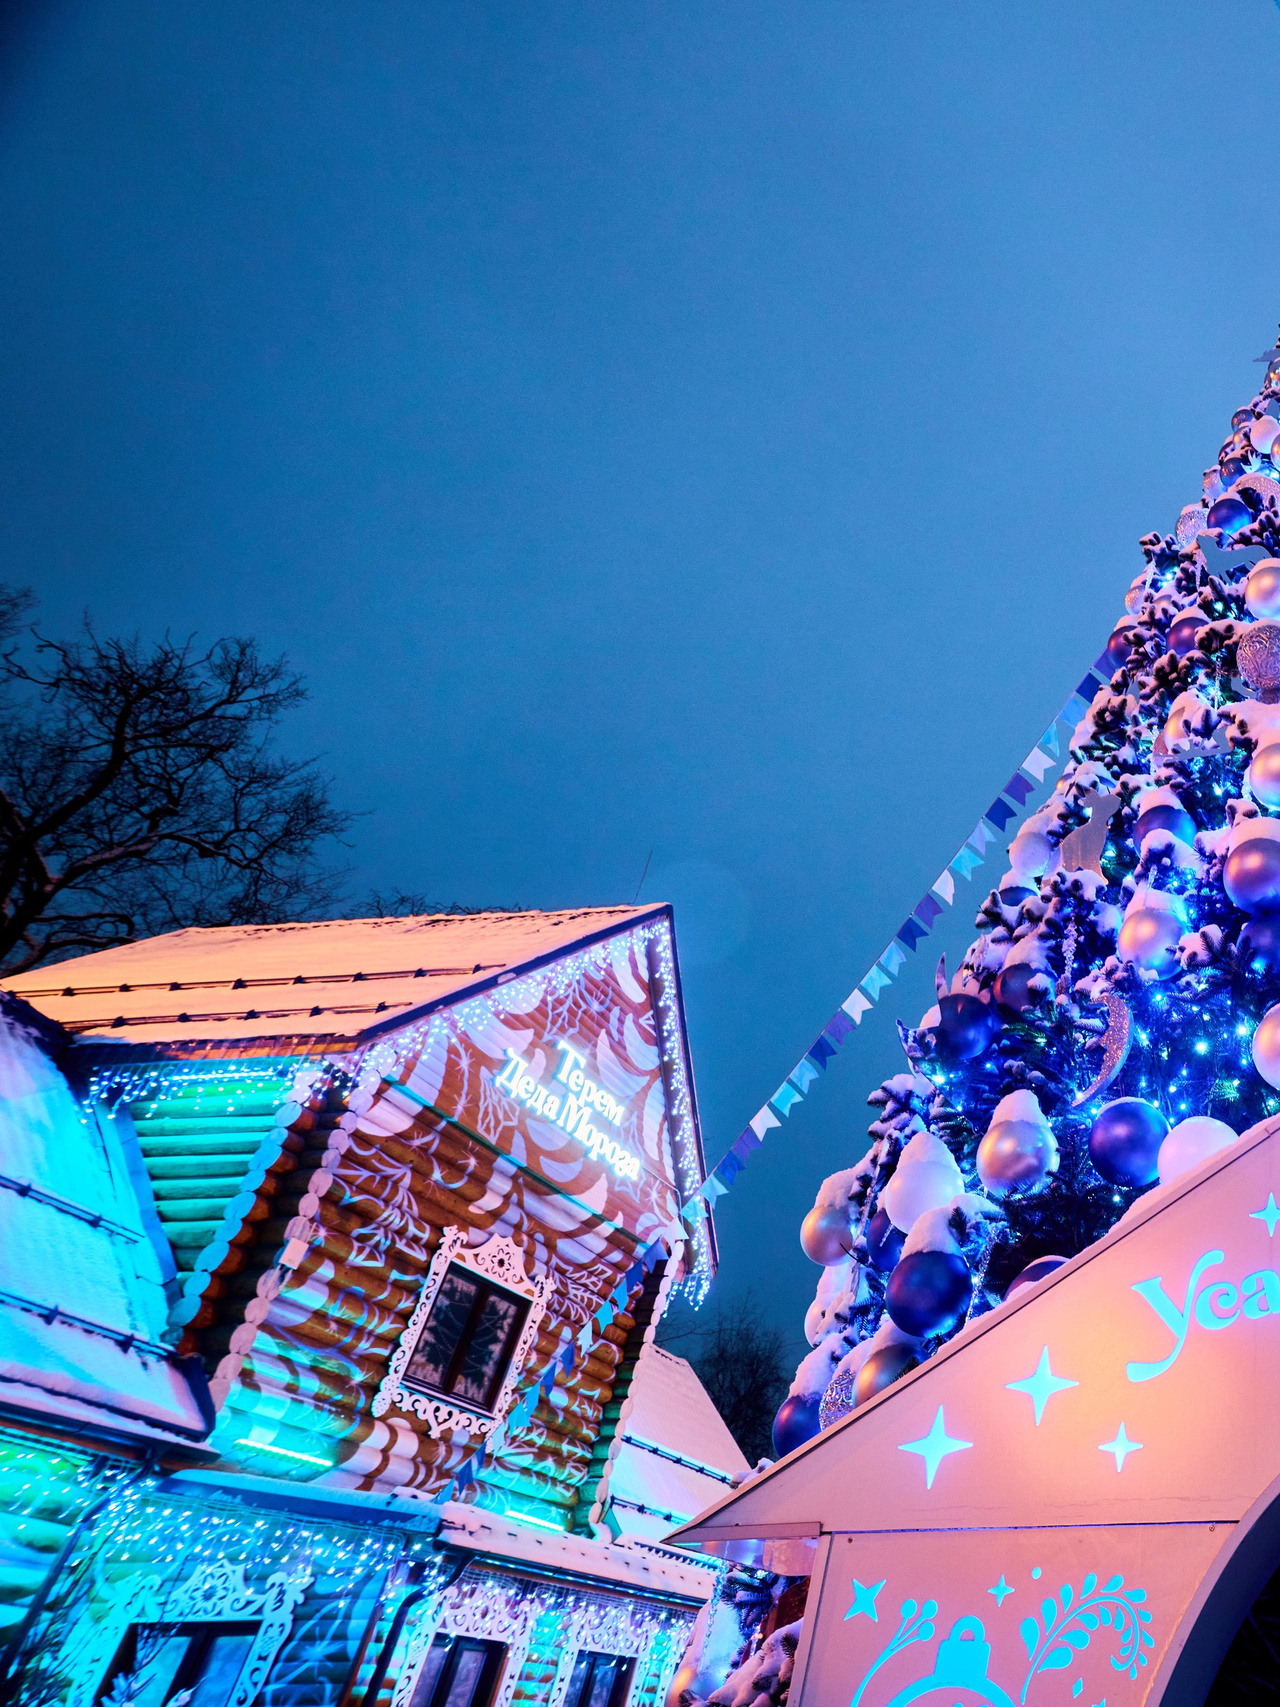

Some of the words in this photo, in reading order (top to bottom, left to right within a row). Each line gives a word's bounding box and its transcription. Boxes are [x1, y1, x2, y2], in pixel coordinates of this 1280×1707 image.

[495, 1047, 558, 1119] Деда
[556, 1092, 640, 1181] Мороза
[557, 1040, 625, 1126] Терем
